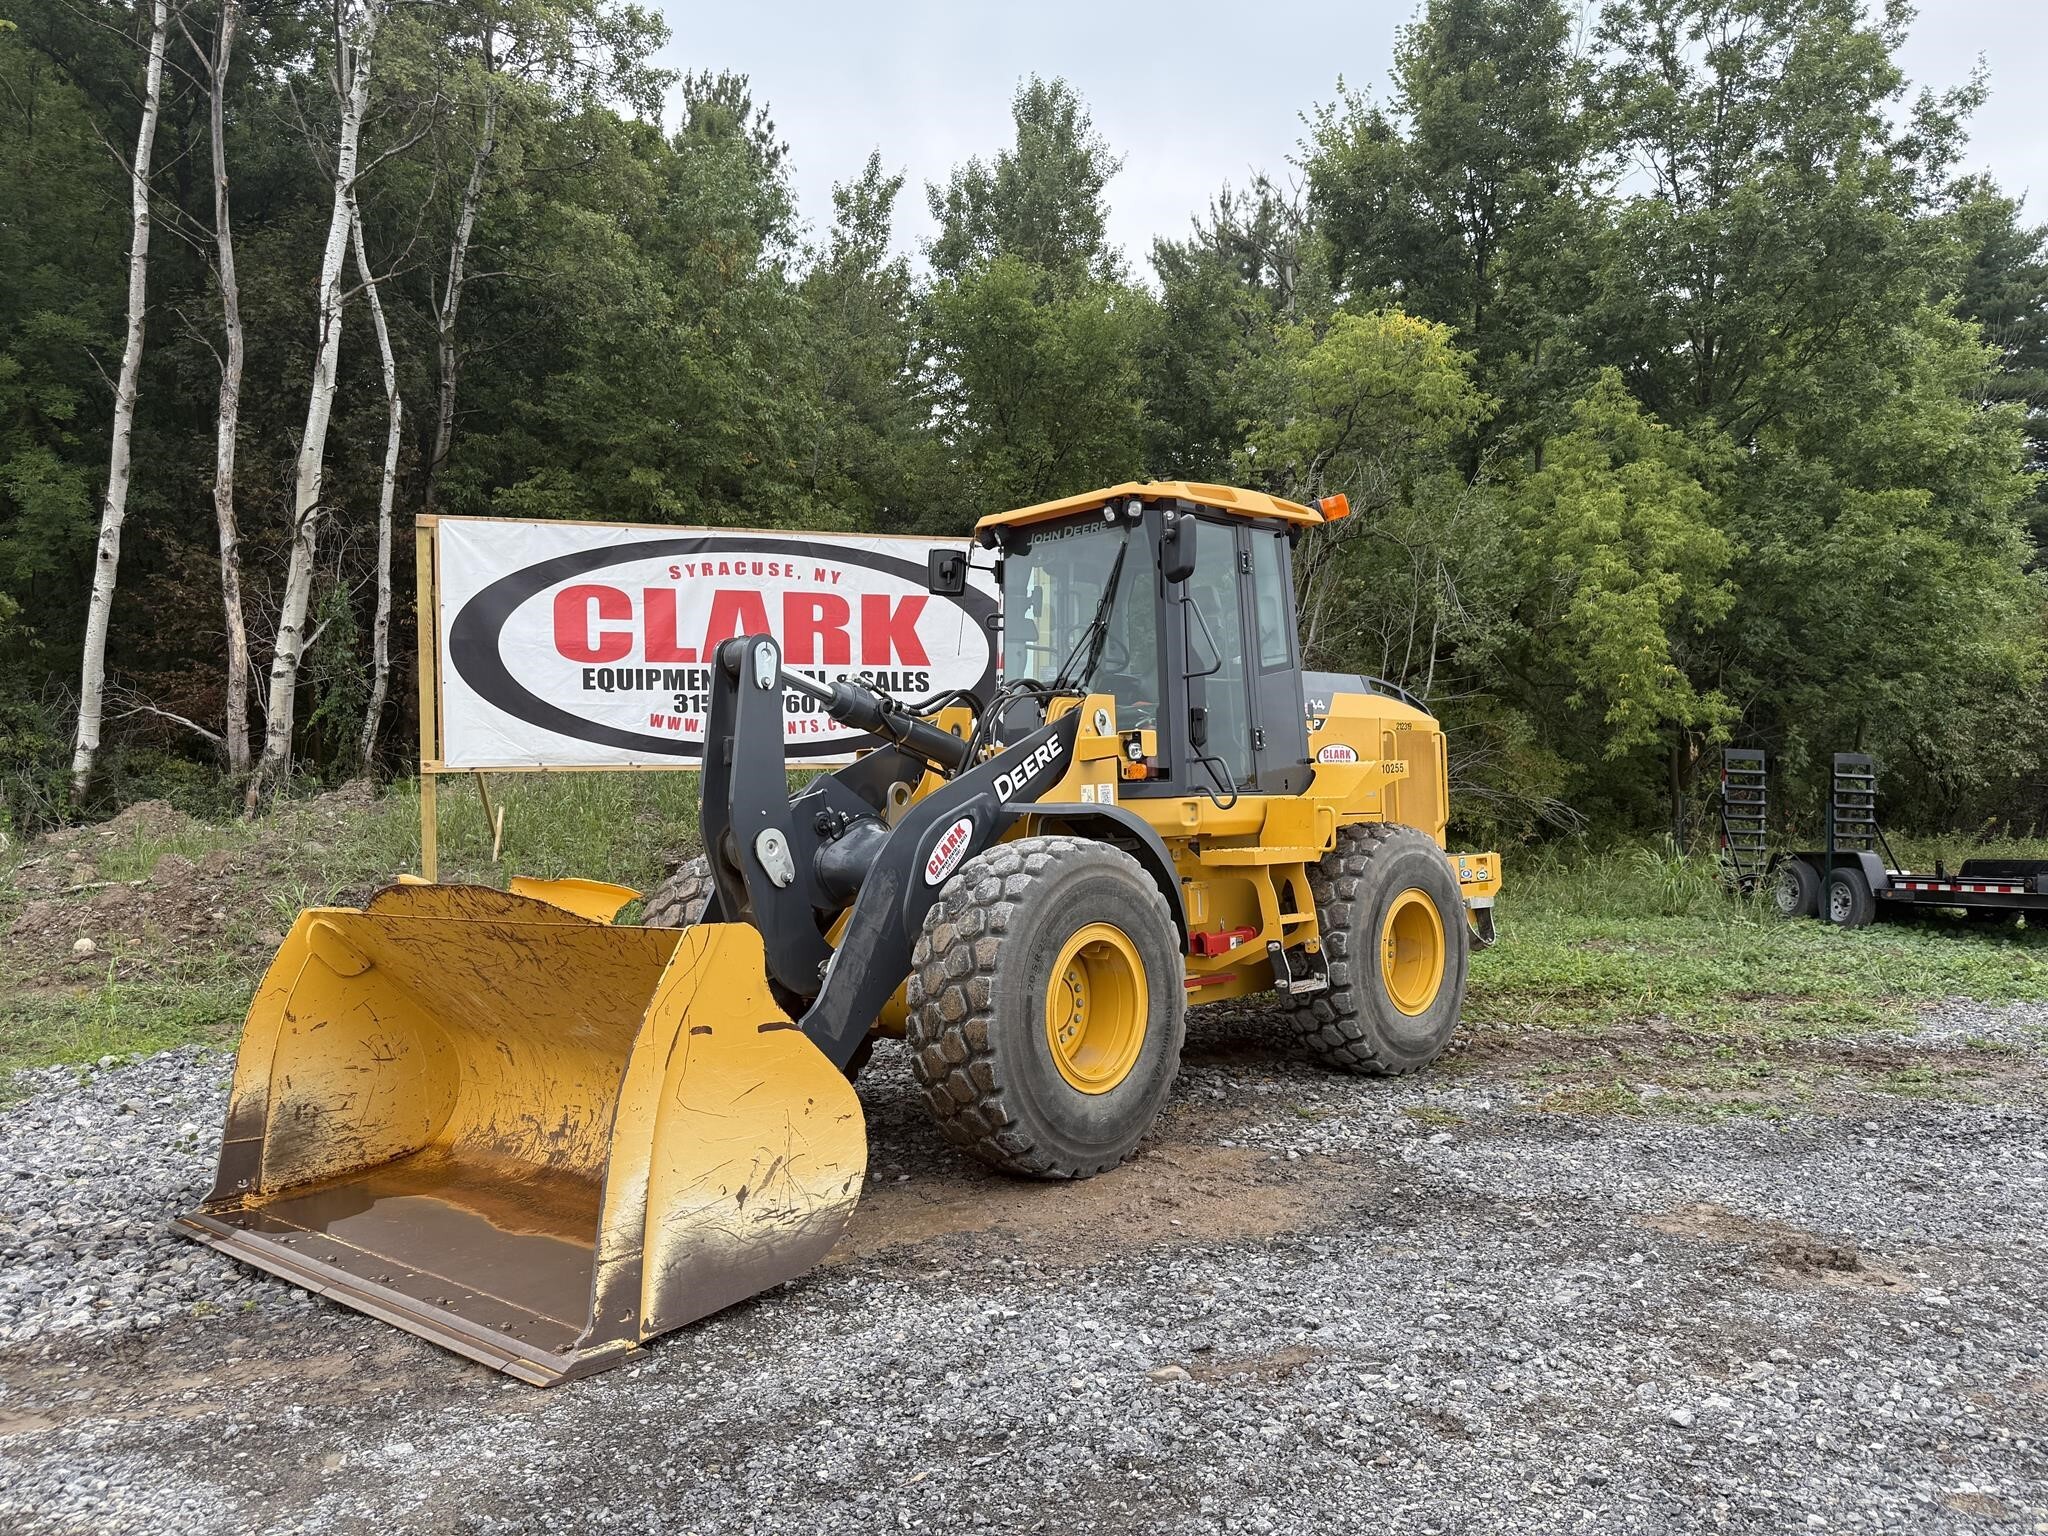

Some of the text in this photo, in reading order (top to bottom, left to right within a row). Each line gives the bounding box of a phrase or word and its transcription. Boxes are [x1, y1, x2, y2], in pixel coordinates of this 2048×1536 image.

[1026, 520, 1108, 545] JOHN DEERE
[668, 561, 841, 584] SYRACUSE, NY
[553, 583, 932, 666] CLARK
[582, 667, 711, 692] EQUIPMEN
[1323, 749, 1351, 760] CLARK
[993, 733, 1064, 804] DEERE
[1381, 763, 1404, 774] 10255
[927, 822, 966, 876] CLARK
